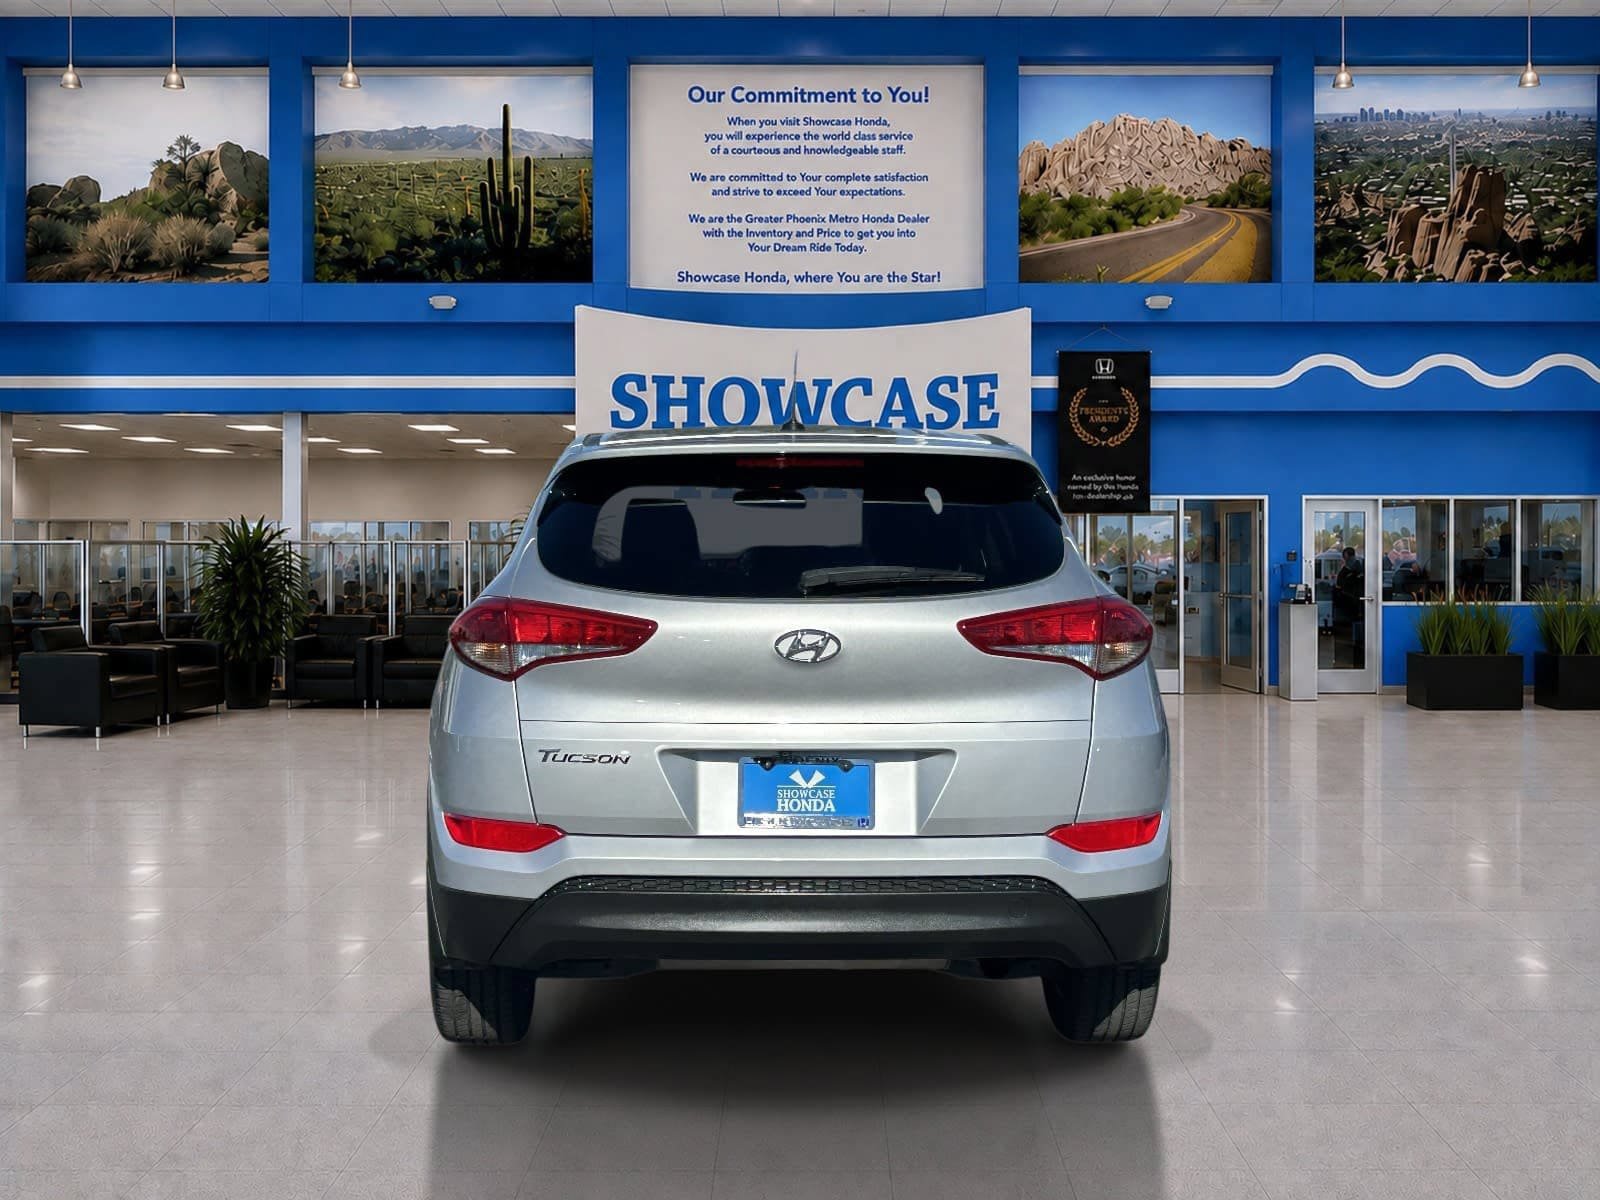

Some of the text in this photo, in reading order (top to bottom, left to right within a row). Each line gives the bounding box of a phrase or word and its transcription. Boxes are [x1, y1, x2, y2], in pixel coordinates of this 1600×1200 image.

[687, 85, 930, 104] Our Commitment to You!
[726, 116, 891, 129] When you visit Showcase Honda,
[704, 130, 914, 144] you will experience the world class service
[710, 144, 721, 155] of
[722, 147, 730, 155] a
[730, 146, 781, 156] courteous
[782, 144, 802, 155] and
[881, 144, 906, 155] staff.
[689, 171, 929, 185] We are committed to Your complete satisfaction
[711, 186, 906, 200] and strive to exceed Your expectations.
[688, 213, 931, 224] We are the Greater Phoenix Metro Honda Dealer
[702, 227, 917, 241] with the Inventory and Price to get you into
[747, 242, 868, 255] Your Dream Ride Today.
[677, 270, 941, 286] Showcase Honda, where You are the Star!
[610, 373, 1001, 429] SHOWCASE
[776, 789, 836, 798] SHOWCASE
[776, 798, 837, 812] HONDA
